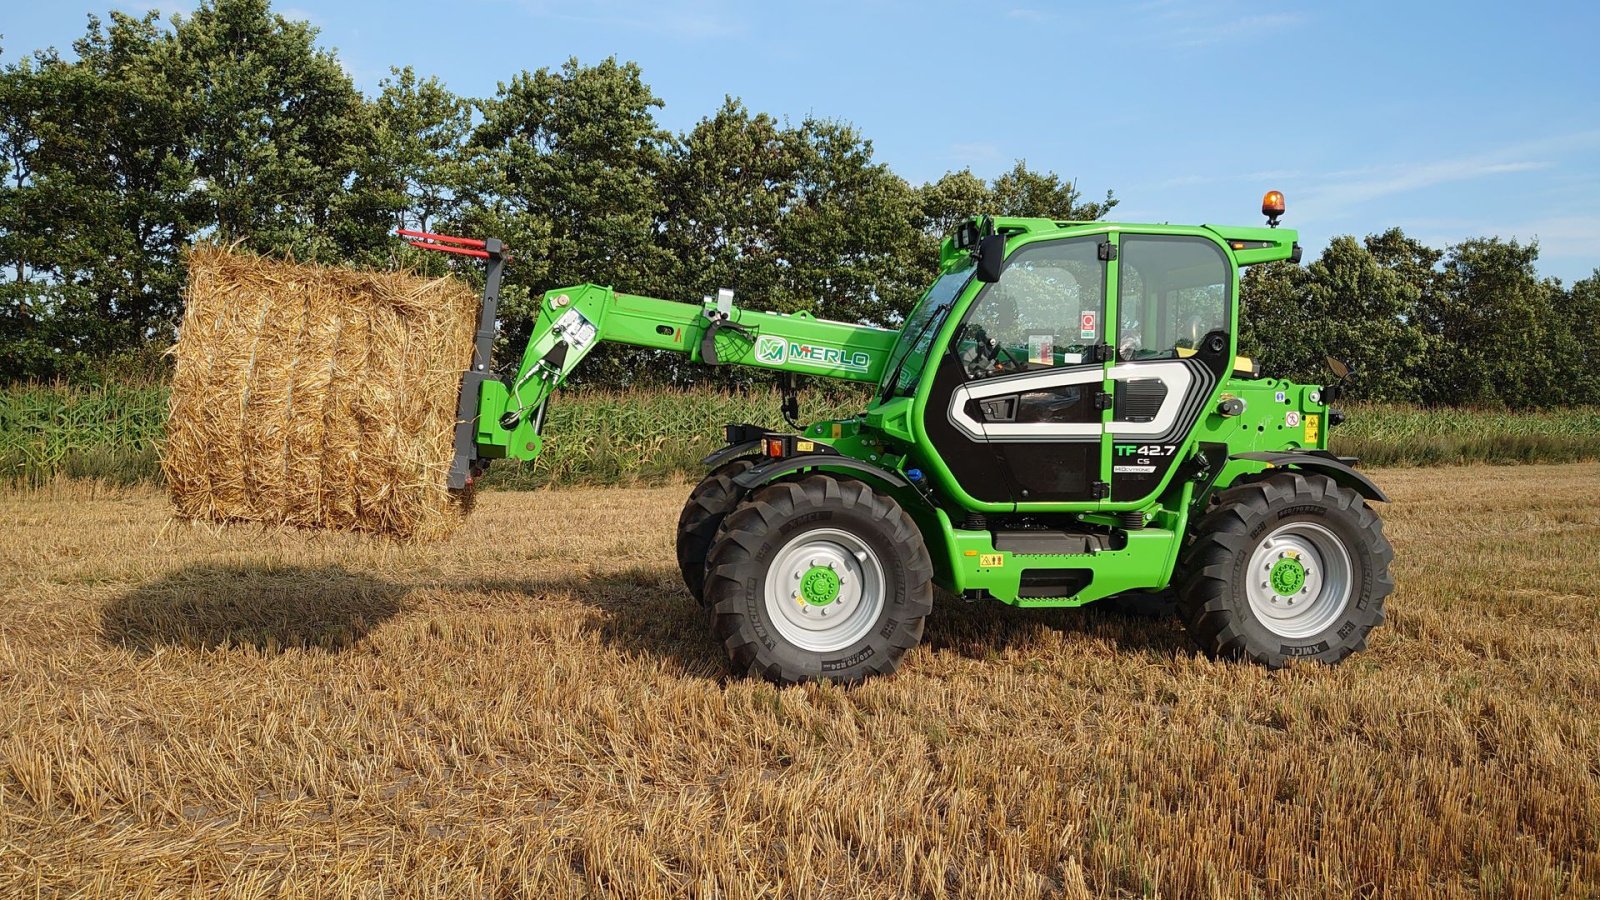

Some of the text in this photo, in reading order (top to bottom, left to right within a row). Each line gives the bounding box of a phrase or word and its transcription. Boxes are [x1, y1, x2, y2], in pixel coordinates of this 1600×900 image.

[789, 343, 870, 367] MERLO
[1114, 445, 1176, 456] TF42.7
[1289, 644, 1320, 656] XMCL
